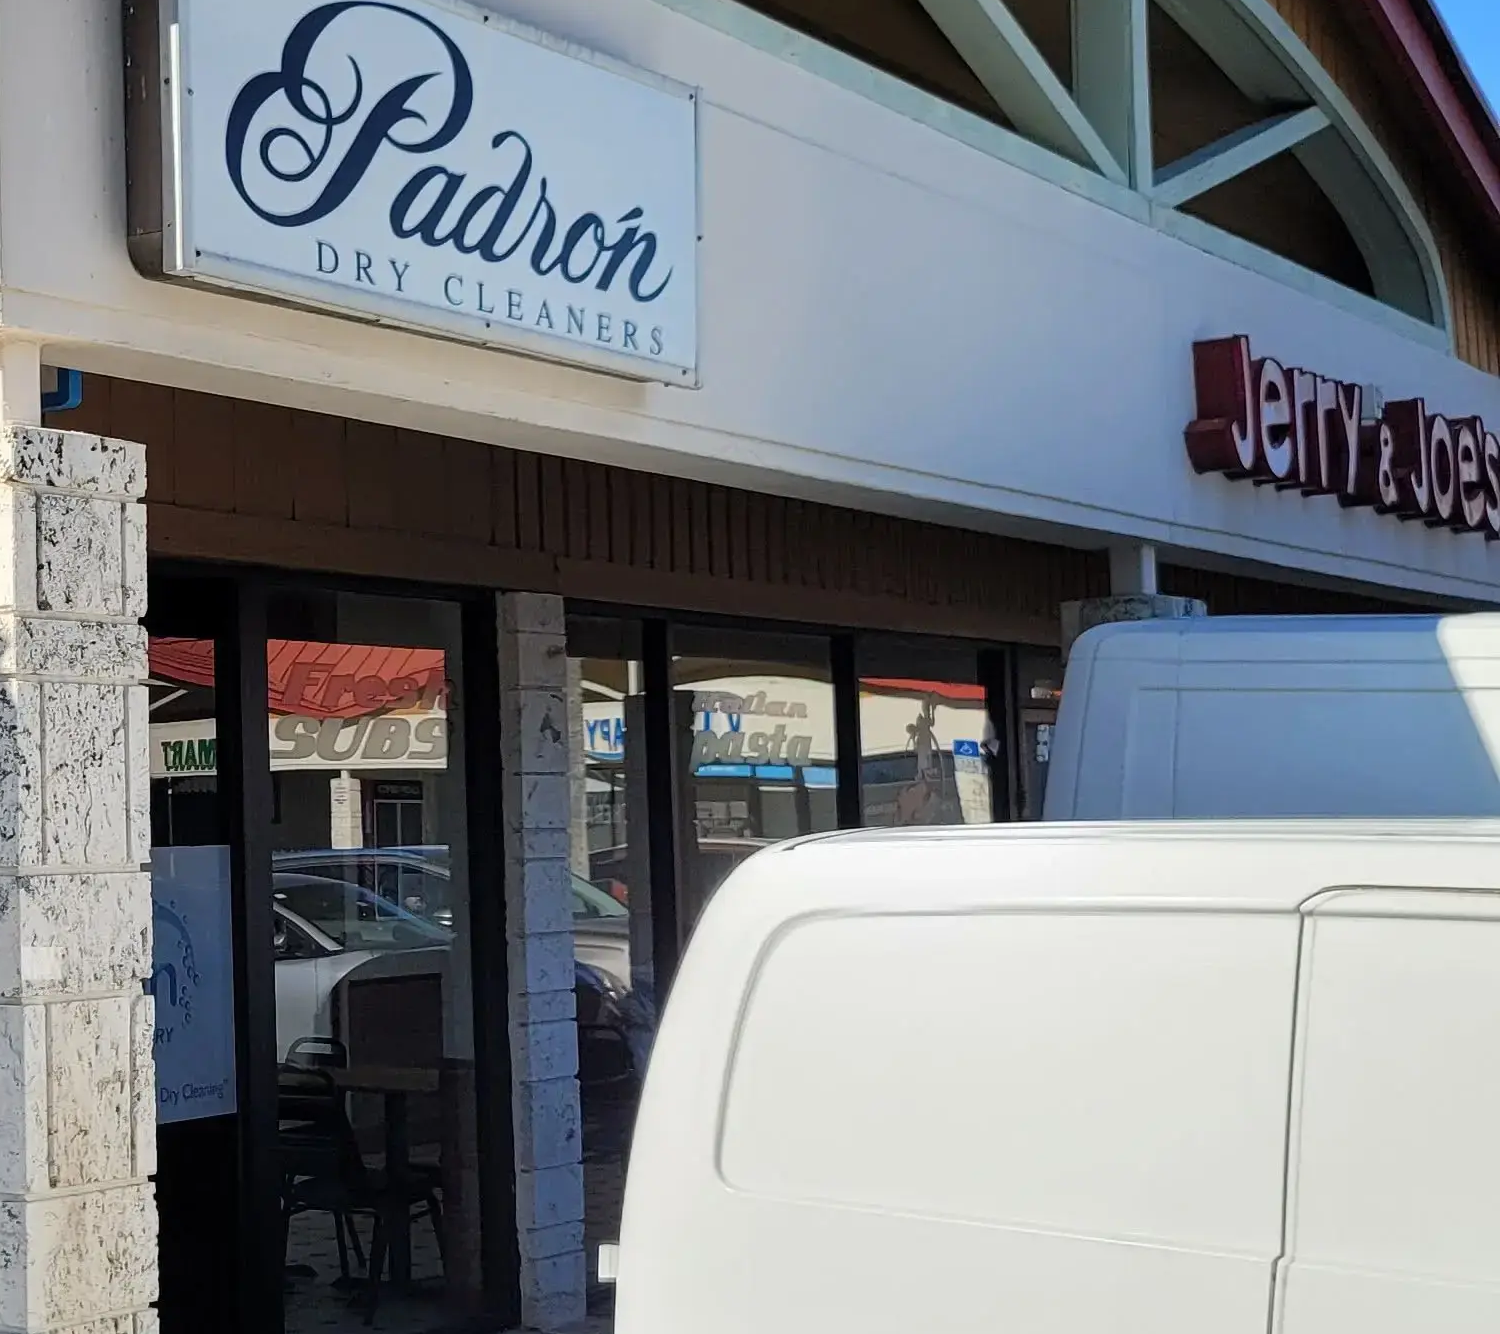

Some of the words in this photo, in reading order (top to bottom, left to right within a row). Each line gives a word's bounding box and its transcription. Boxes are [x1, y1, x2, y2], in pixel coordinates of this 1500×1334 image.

[316, 239, 411, 293] DRY
[443, 272, 666, 357] CLEANERS
[1190, 334, 1362, 500] Jerry
[1377, 419, 1399, 507] &
[280, 662, 460, 712] Fresh
[270, 714, 455, 762] SUBS
[160, 1086, 180, 1106] Dry
